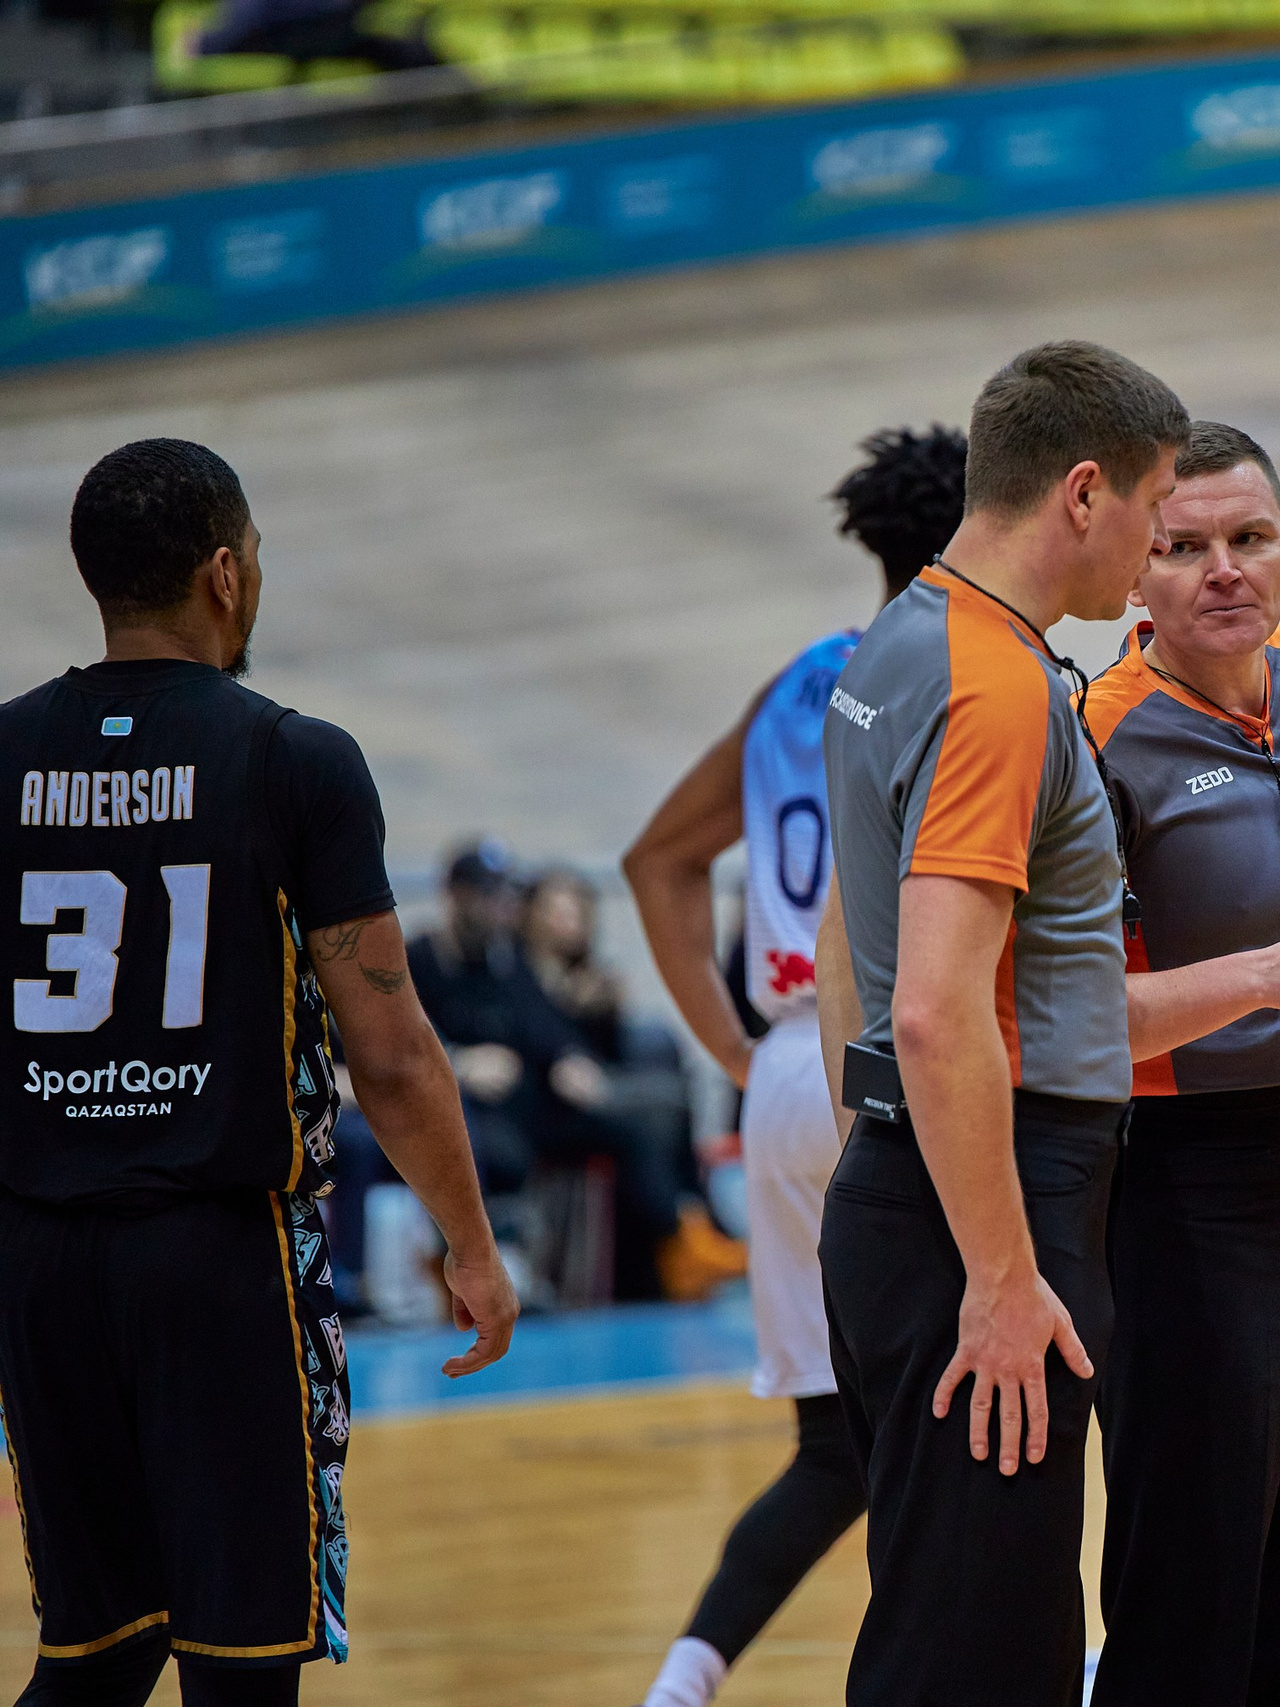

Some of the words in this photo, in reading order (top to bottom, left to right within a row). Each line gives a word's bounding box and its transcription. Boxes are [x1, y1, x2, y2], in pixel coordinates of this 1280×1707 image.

[20, 765, 195, 827] ANDERSON
[1185, 766, 1234, 795] ZEDO
[777, 795, 825, 910] 0
[13, 863, 211, 1033] 31
[23, 1059, 212, 1100] SportQory
[65, 1101, 172, 1118] QAZAQSTAN
